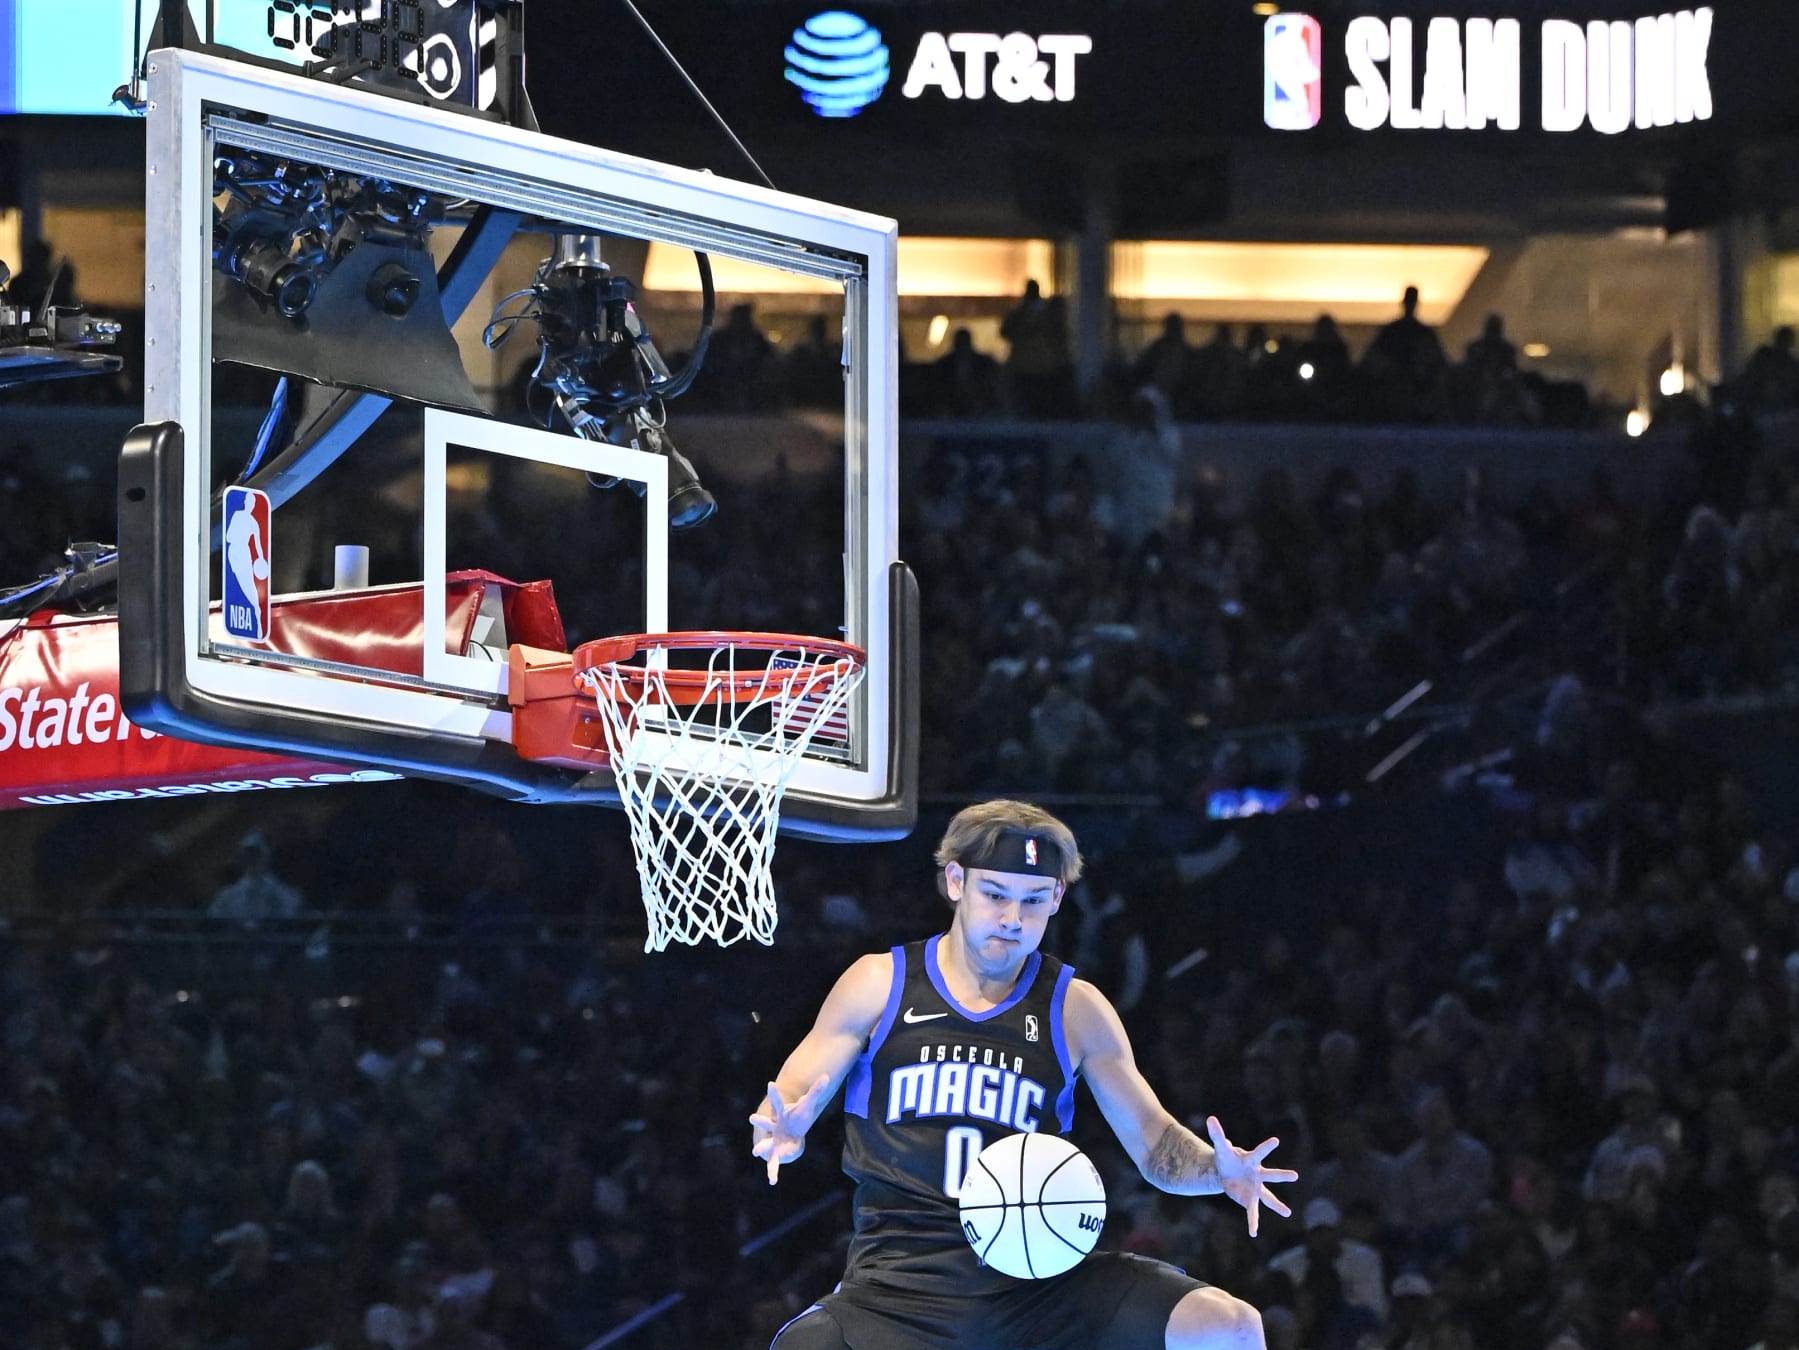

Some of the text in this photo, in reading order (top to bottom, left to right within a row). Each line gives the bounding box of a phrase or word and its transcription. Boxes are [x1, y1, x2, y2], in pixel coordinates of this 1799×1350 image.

[902, 32, 1093, 103] AT&T
[1344, 6, 1713, 134] SLAM DUNK
[230, 604, 253, 632] NBA
[0, 682, 164, 750] State
[920, 1045, 1024, 1075] OSCEOLA
[886, 1061, 1047, 1133] MAGIC
[944, 1125, 983, 1199] 0
